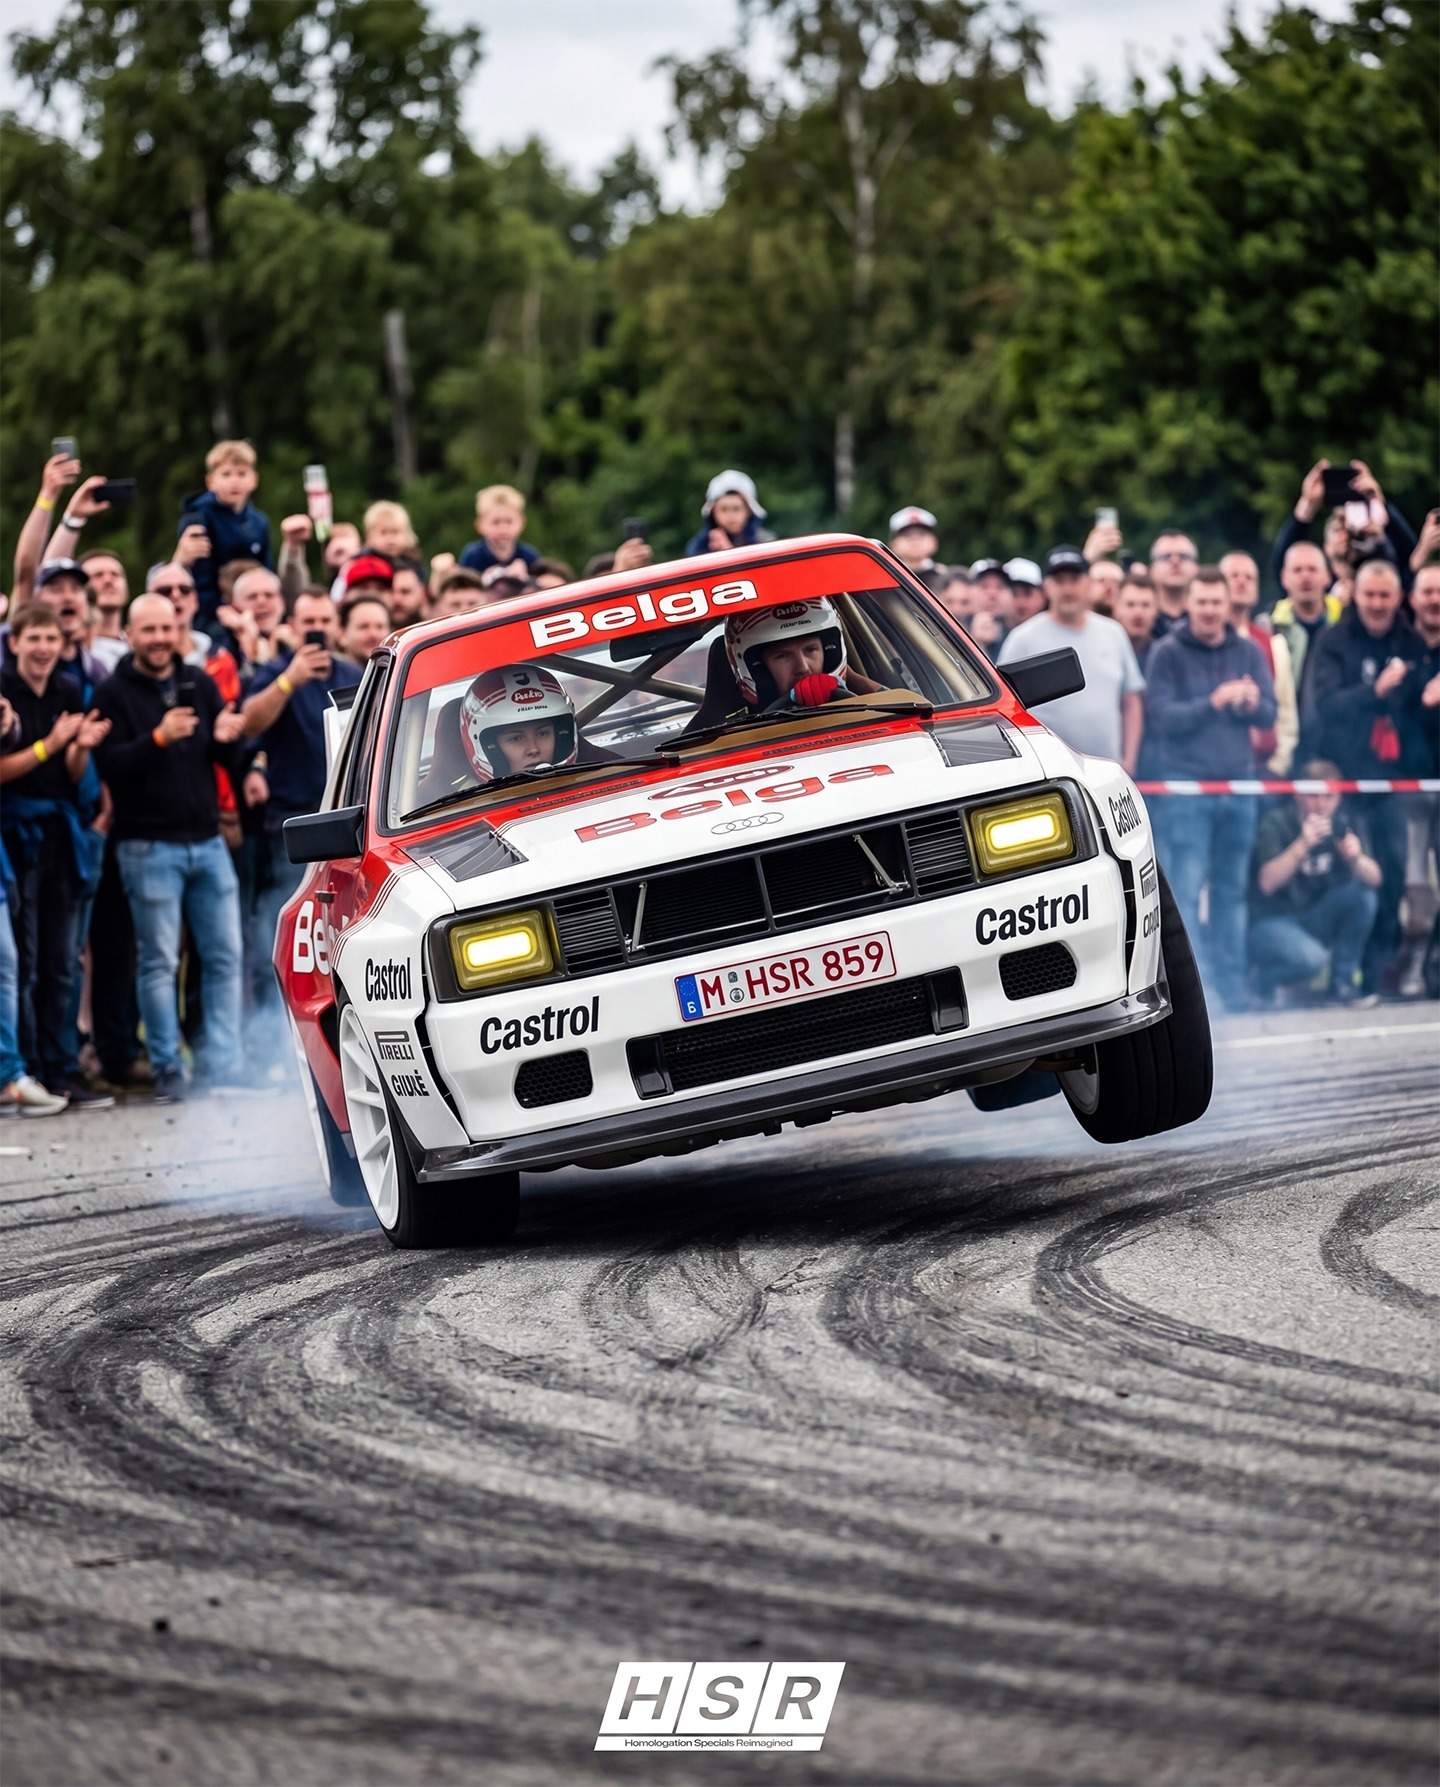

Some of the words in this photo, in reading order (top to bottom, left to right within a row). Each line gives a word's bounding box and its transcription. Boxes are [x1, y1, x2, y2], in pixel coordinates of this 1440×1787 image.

[529, 579, 759, 648] Belga
[574, 764, 894, 843] Belga
[1108, 786, 1141, 838] Castrol
[975, 884, 1090, 945] Castrol
[365, 957, 412, 1002] Castrol
[700, 975, 726, 1009] M
[745, 957, 815, 999] HSR
[822, 941, 884, 981] 859
[374, 1031, 415, 1060] PIRELLI
[480, 996, 600, 1055] Castrol
